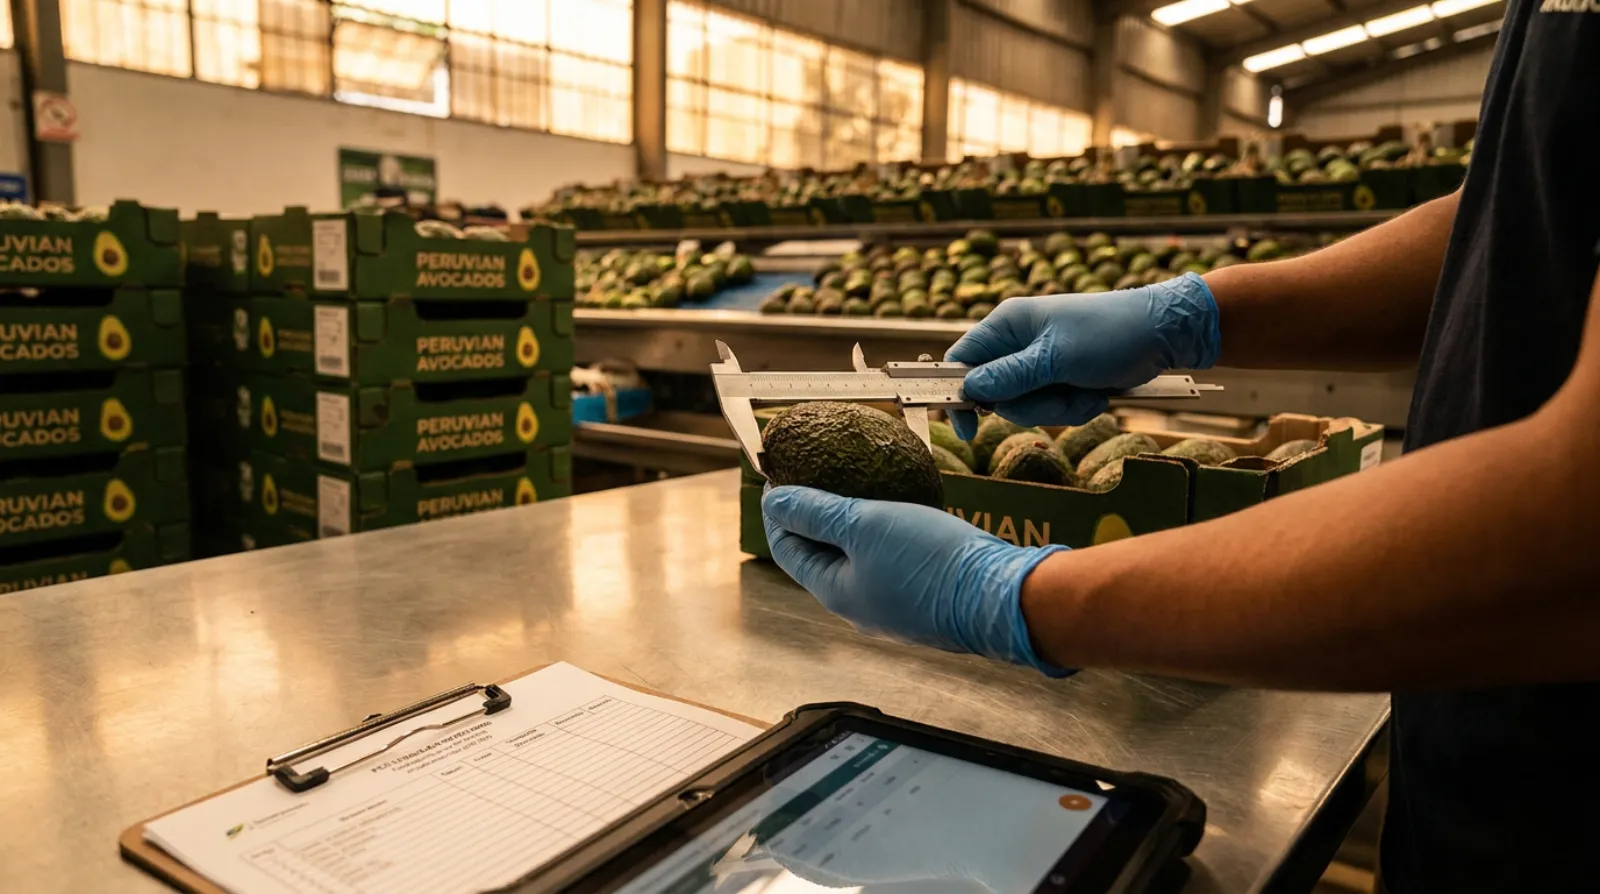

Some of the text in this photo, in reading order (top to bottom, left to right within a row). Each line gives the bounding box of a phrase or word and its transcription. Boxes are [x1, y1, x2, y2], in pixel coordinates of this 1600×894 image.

[416, 251, 505, 270] PERUVIAN
[416, 271, 506, 288] AVOCADOS
[0, 323, 77, 341] UVIAN
[0, 342, 79, 360] CADOS
[416, 333, 504, 354] PERUVIAN
[416, 352, 505, 371] AVOCADOS
[416, 412, 504, 435] PERUVIAN
[416, 430, 504, 452] AVOCADOS
[417, 488, 504, 517] PERUVIAN
[946, 506, 1050, 547] VIAN
